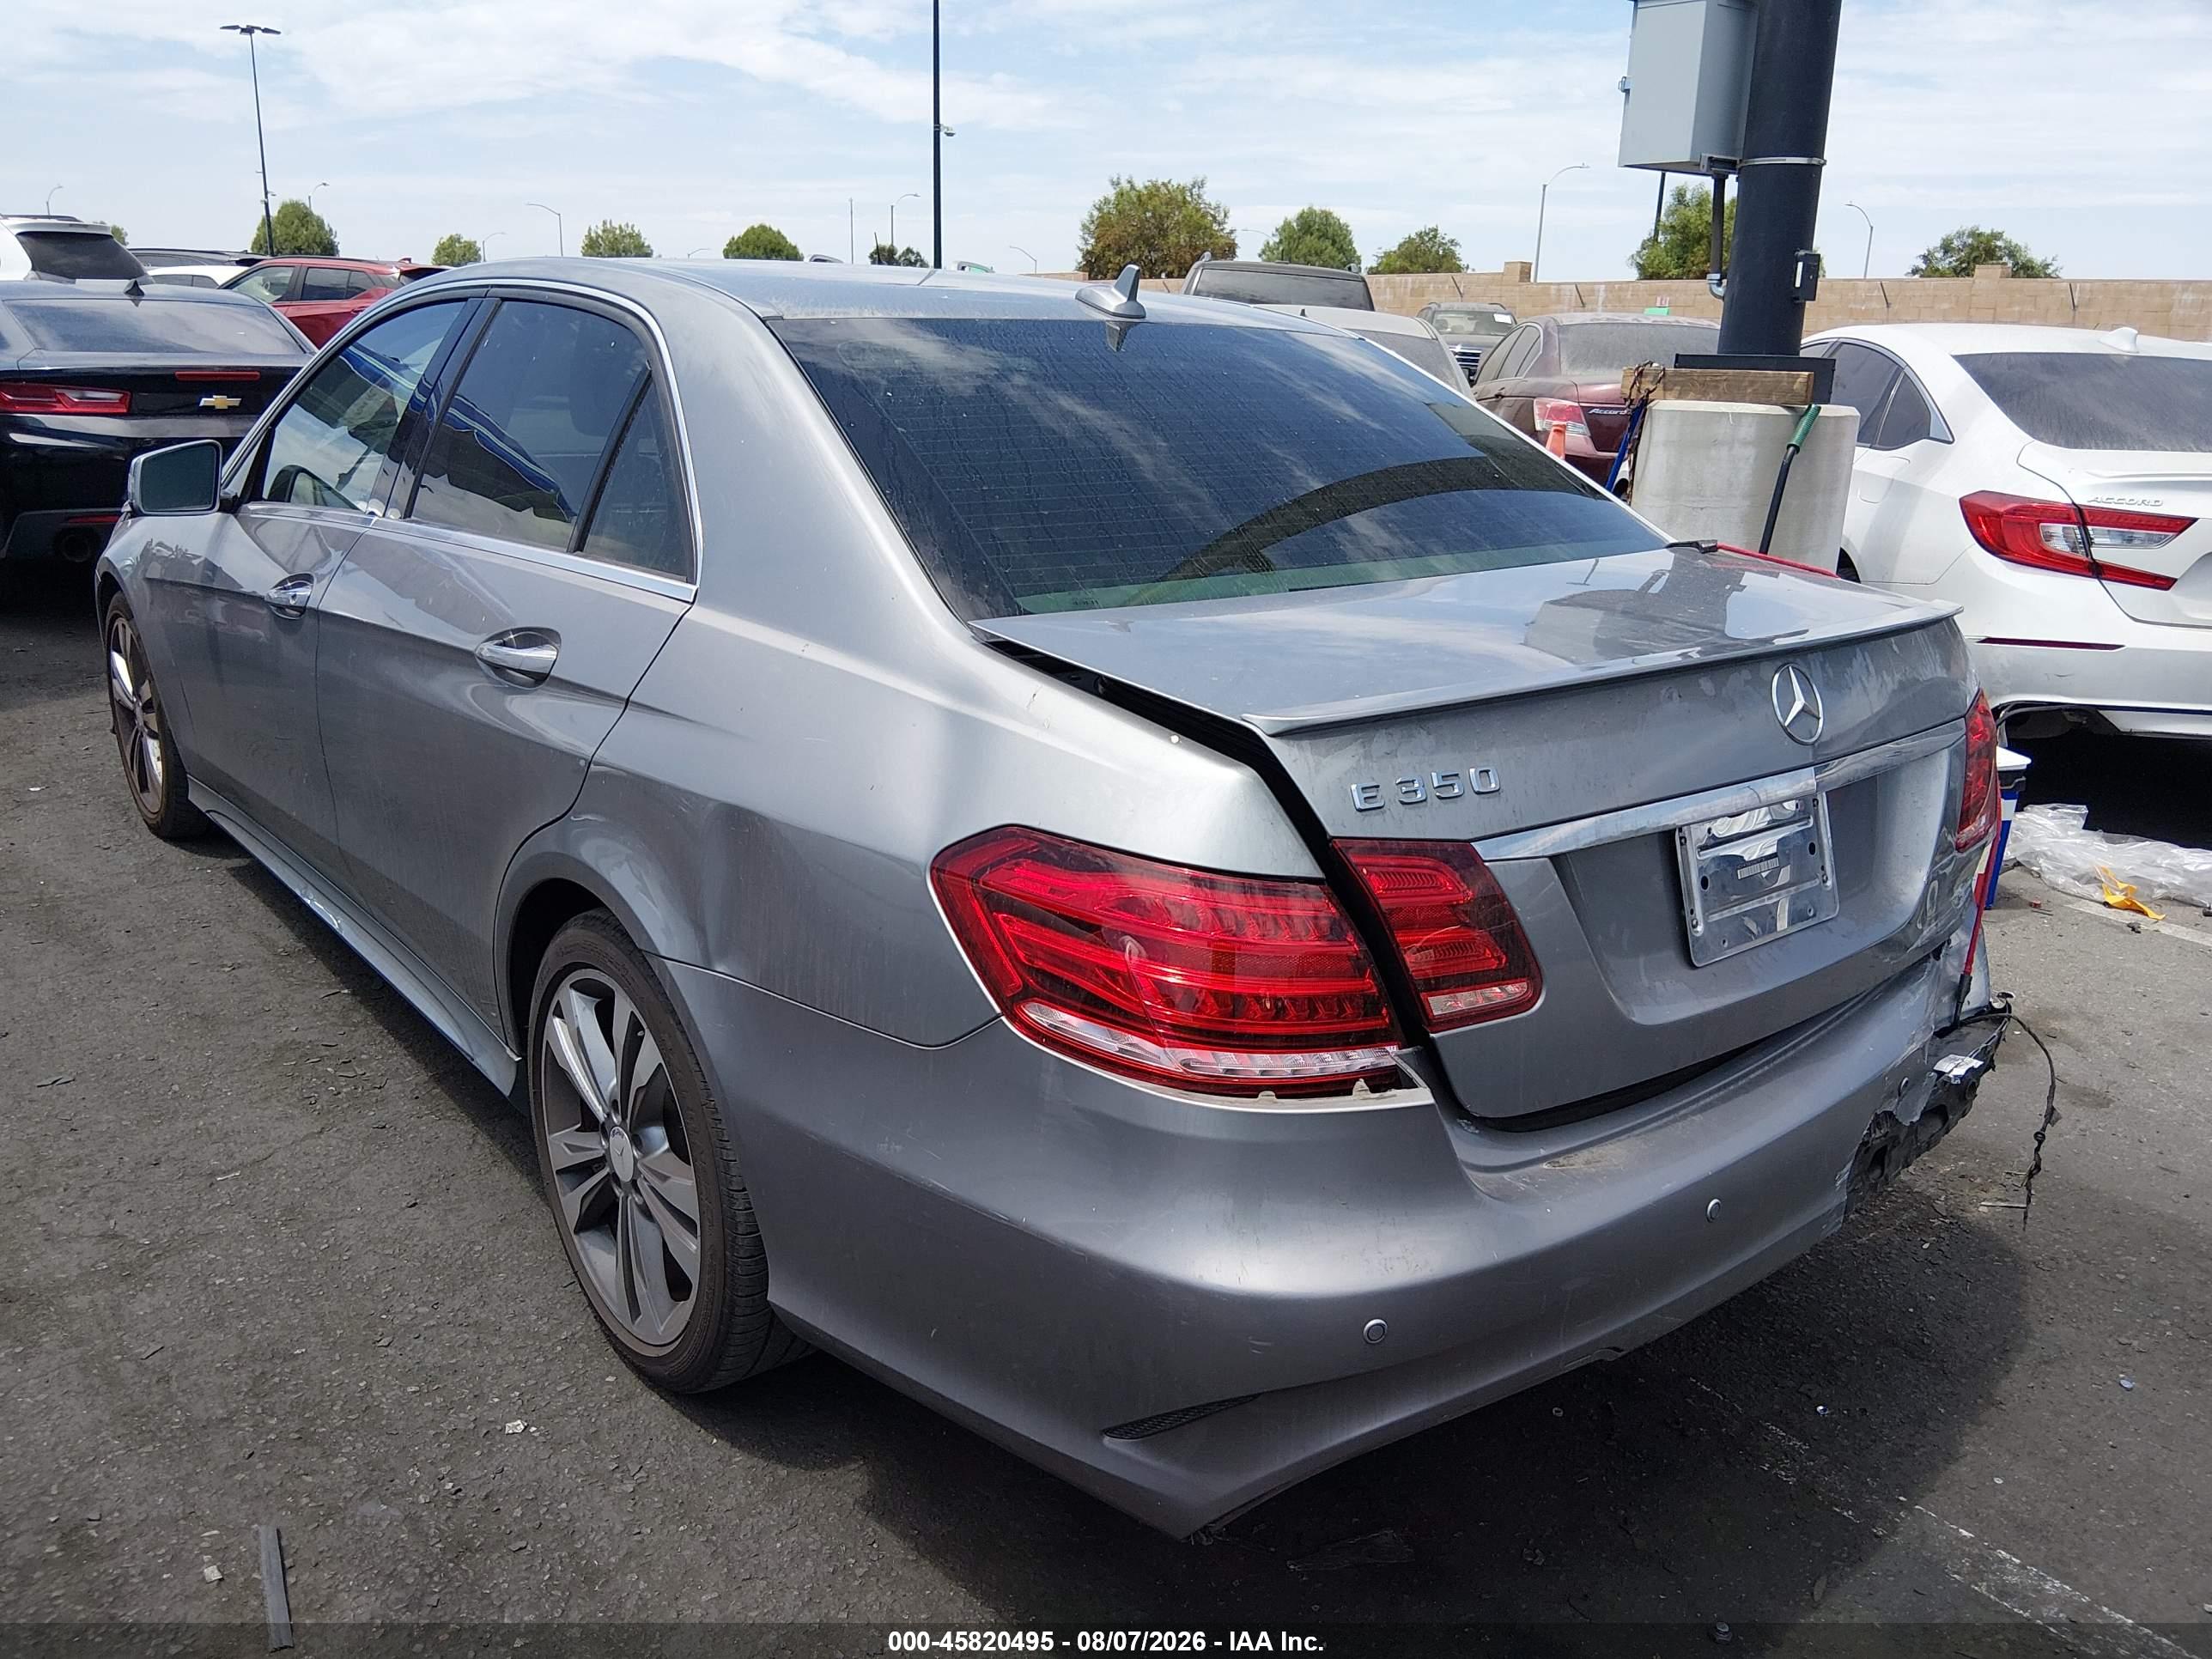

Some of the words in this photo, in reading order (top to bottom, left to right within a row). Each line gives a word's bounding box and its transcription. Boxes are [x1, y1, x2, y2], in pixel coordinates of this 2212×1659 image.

[2087, 495, 2163, 507] ACCORD
[1350, 782, 1385, 812] E
[1395, 766, 1501, 805] 350
